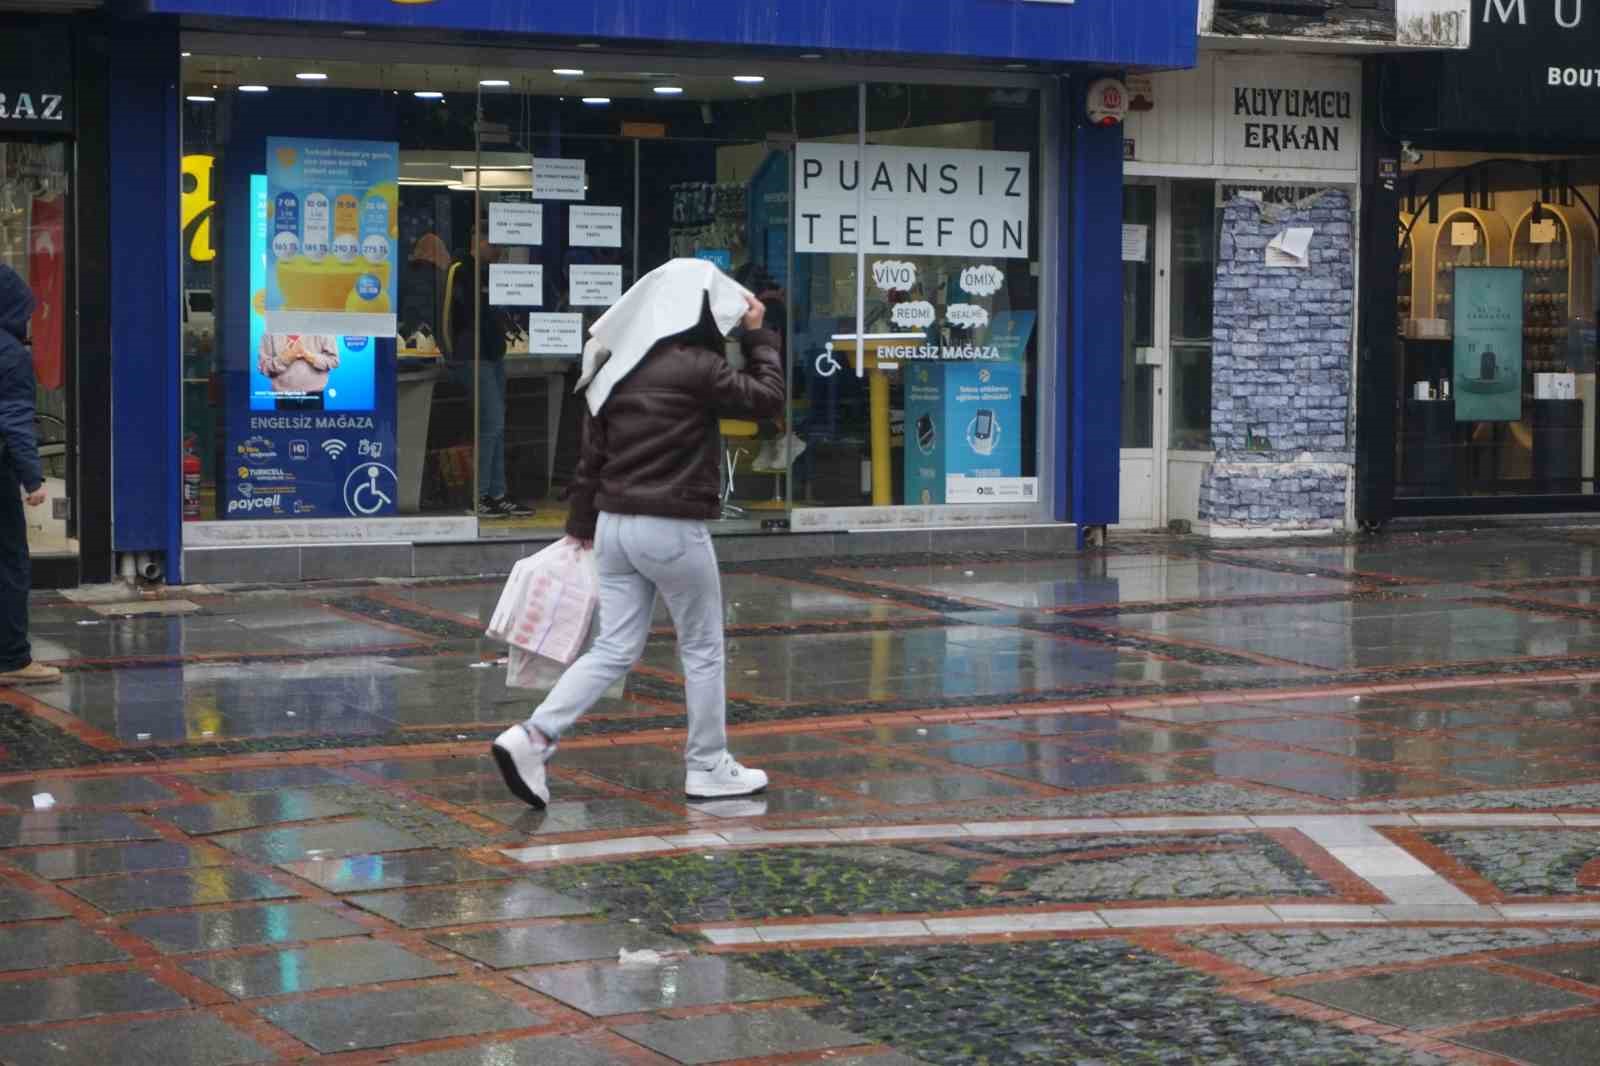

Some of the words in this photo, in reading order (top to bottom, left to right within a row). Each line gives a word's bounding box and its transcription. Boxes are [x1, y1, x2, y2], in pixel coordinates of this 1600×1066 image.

[1233, 87, 1351, 119] KUYUMCU
[1244, 122, 1340, 151] ERKAN
[802, 158, 1022, 197] PUANSIZ
[801, 213, 1023, 250] TELEFON
[877, 344, 939, 359] ENGELSİZ
[942, 344, 1000, 359] MAĞAZA
[250, 415, 312, 429] ENGELSİZ
[315, 415, 375, 429] MAĞAZA
[228, 494, 280, 513] paycell
